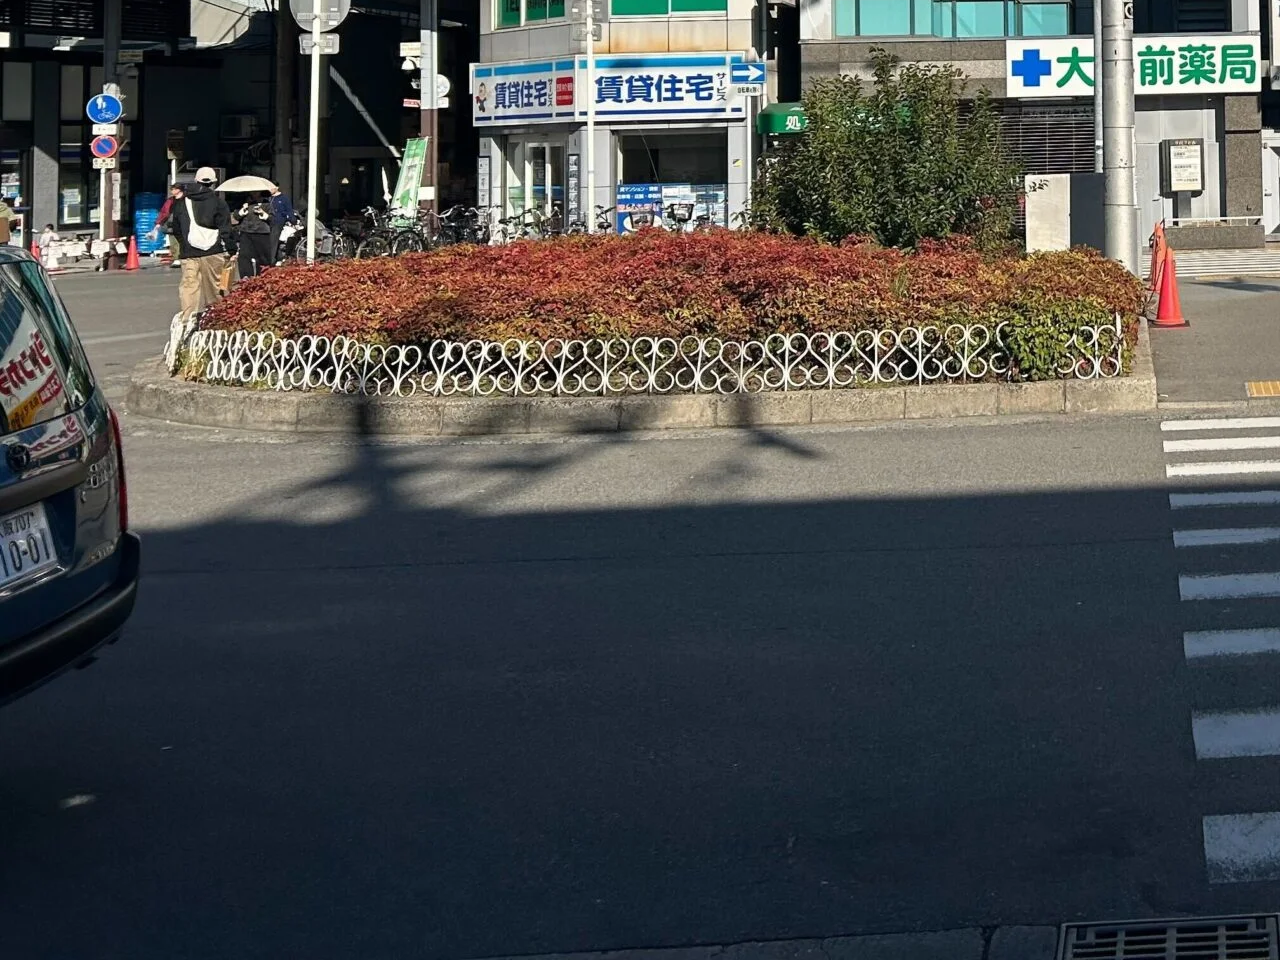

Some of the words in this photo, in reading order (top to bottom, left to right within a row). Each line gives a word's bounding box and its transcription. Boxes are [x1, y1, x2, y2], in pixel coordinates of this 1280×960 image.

[1056, 43, 1258, 88] 大前薬局
[494, 79, 548, 109] 賃貸住宅
[594, 73, 714, 104] 賃貸住宅
[716, 72, 727, 101] サービス
